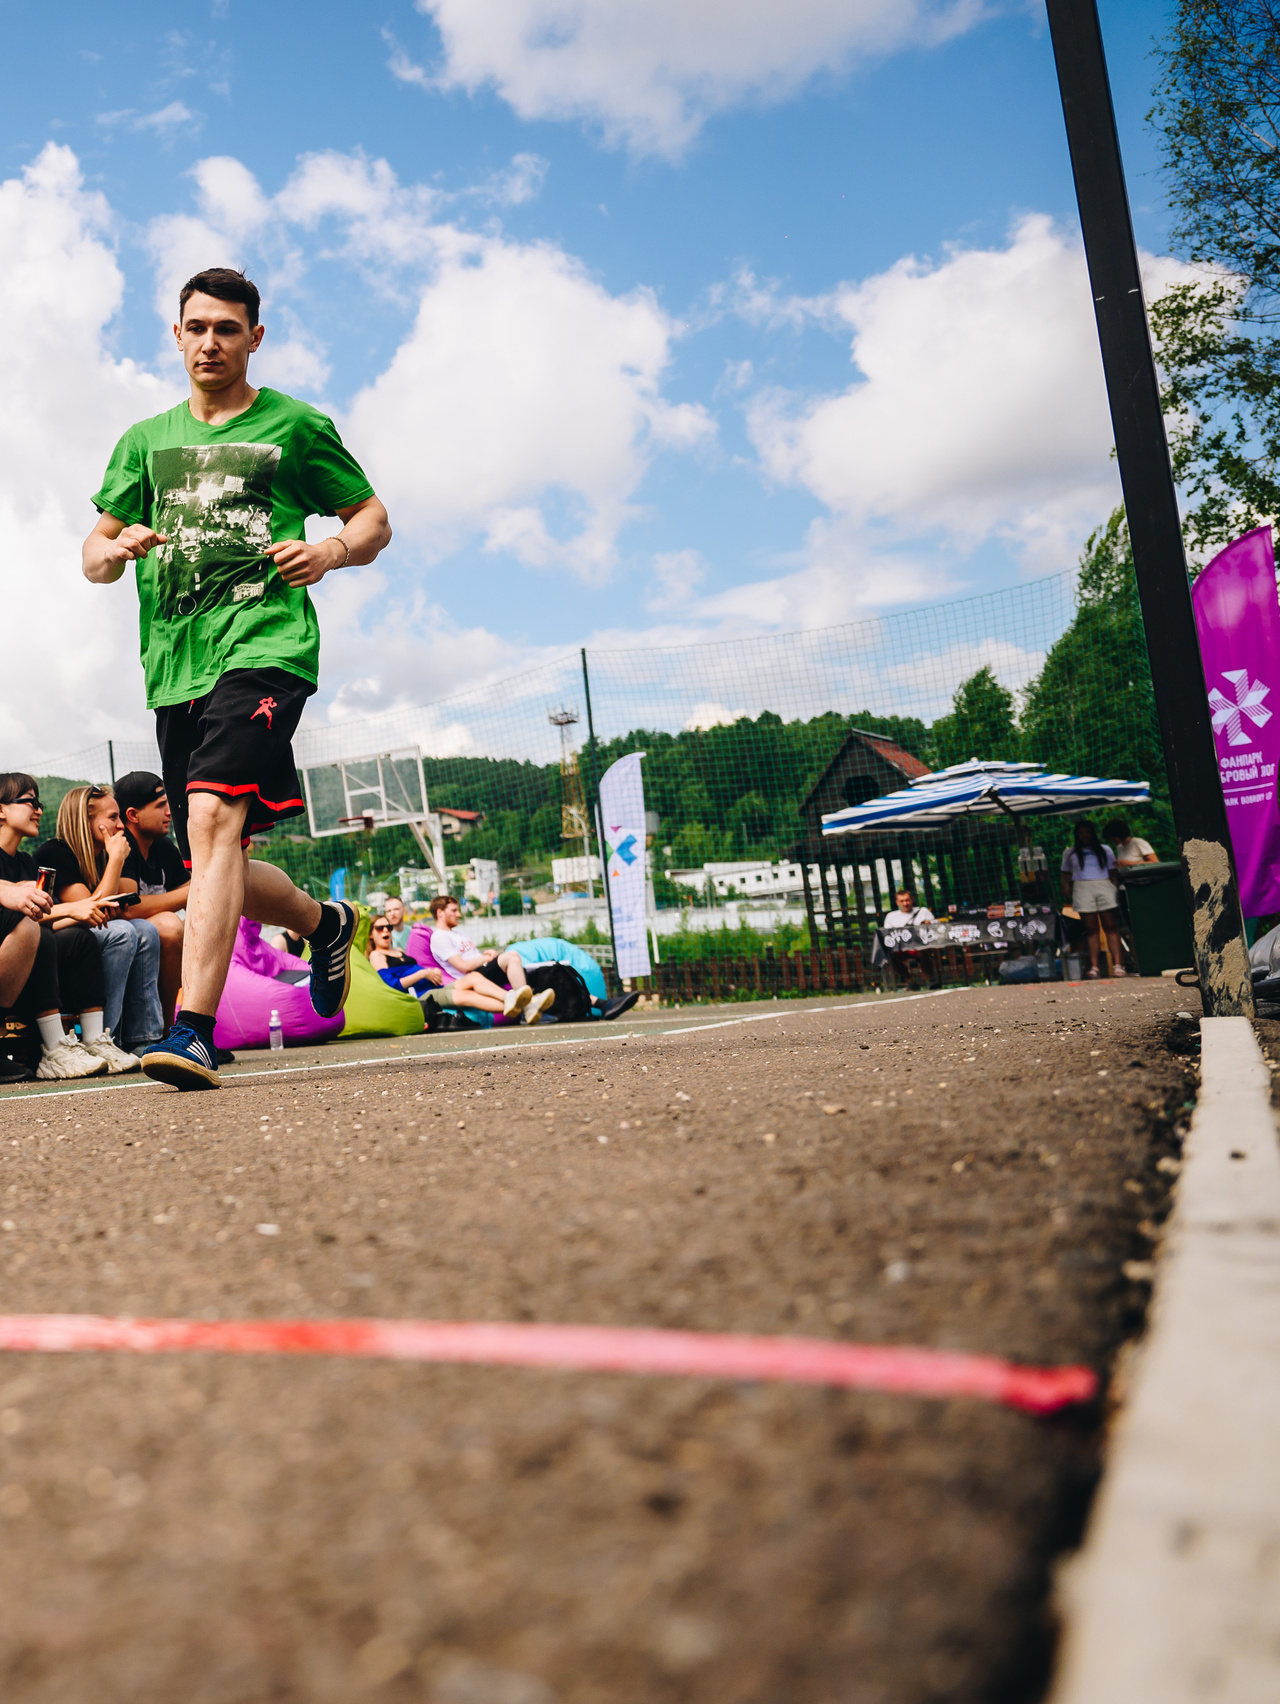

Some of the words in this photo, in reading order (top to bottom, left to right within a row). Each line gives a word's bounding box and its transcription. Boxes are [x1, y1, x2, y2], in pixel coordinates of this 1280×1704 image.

[1220, 751, 1263, 769] ФАНПАРК
[1220, 765, 1258, 783] БРОВЫЙ
[1261, 763, 1275, 777] ЛОГ
